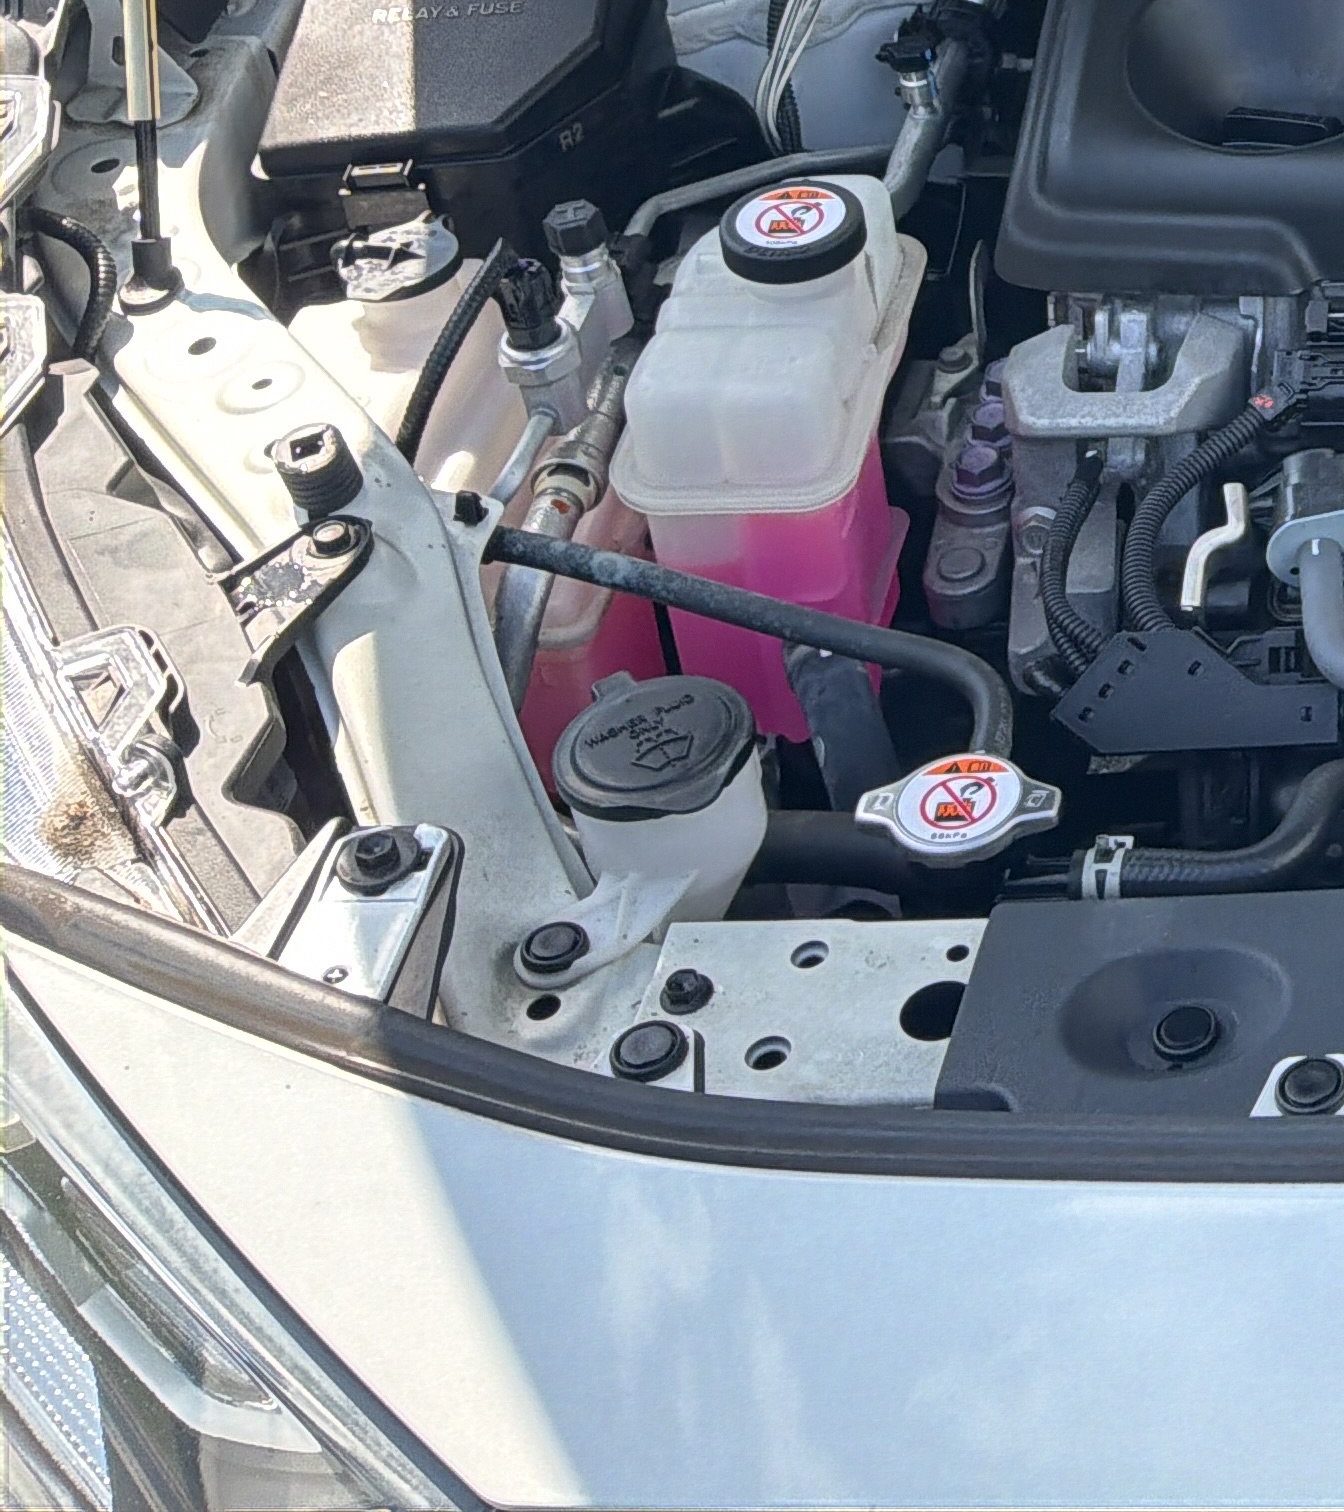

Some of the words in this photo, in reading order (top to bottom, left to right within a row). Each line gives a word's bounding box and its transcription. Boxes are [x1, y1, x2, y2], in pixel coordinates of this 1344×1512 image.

[372, 5, 443, 24] RELAY
[445, 5, 459, 17] &
[467, 1, 523, 16] FUSE
